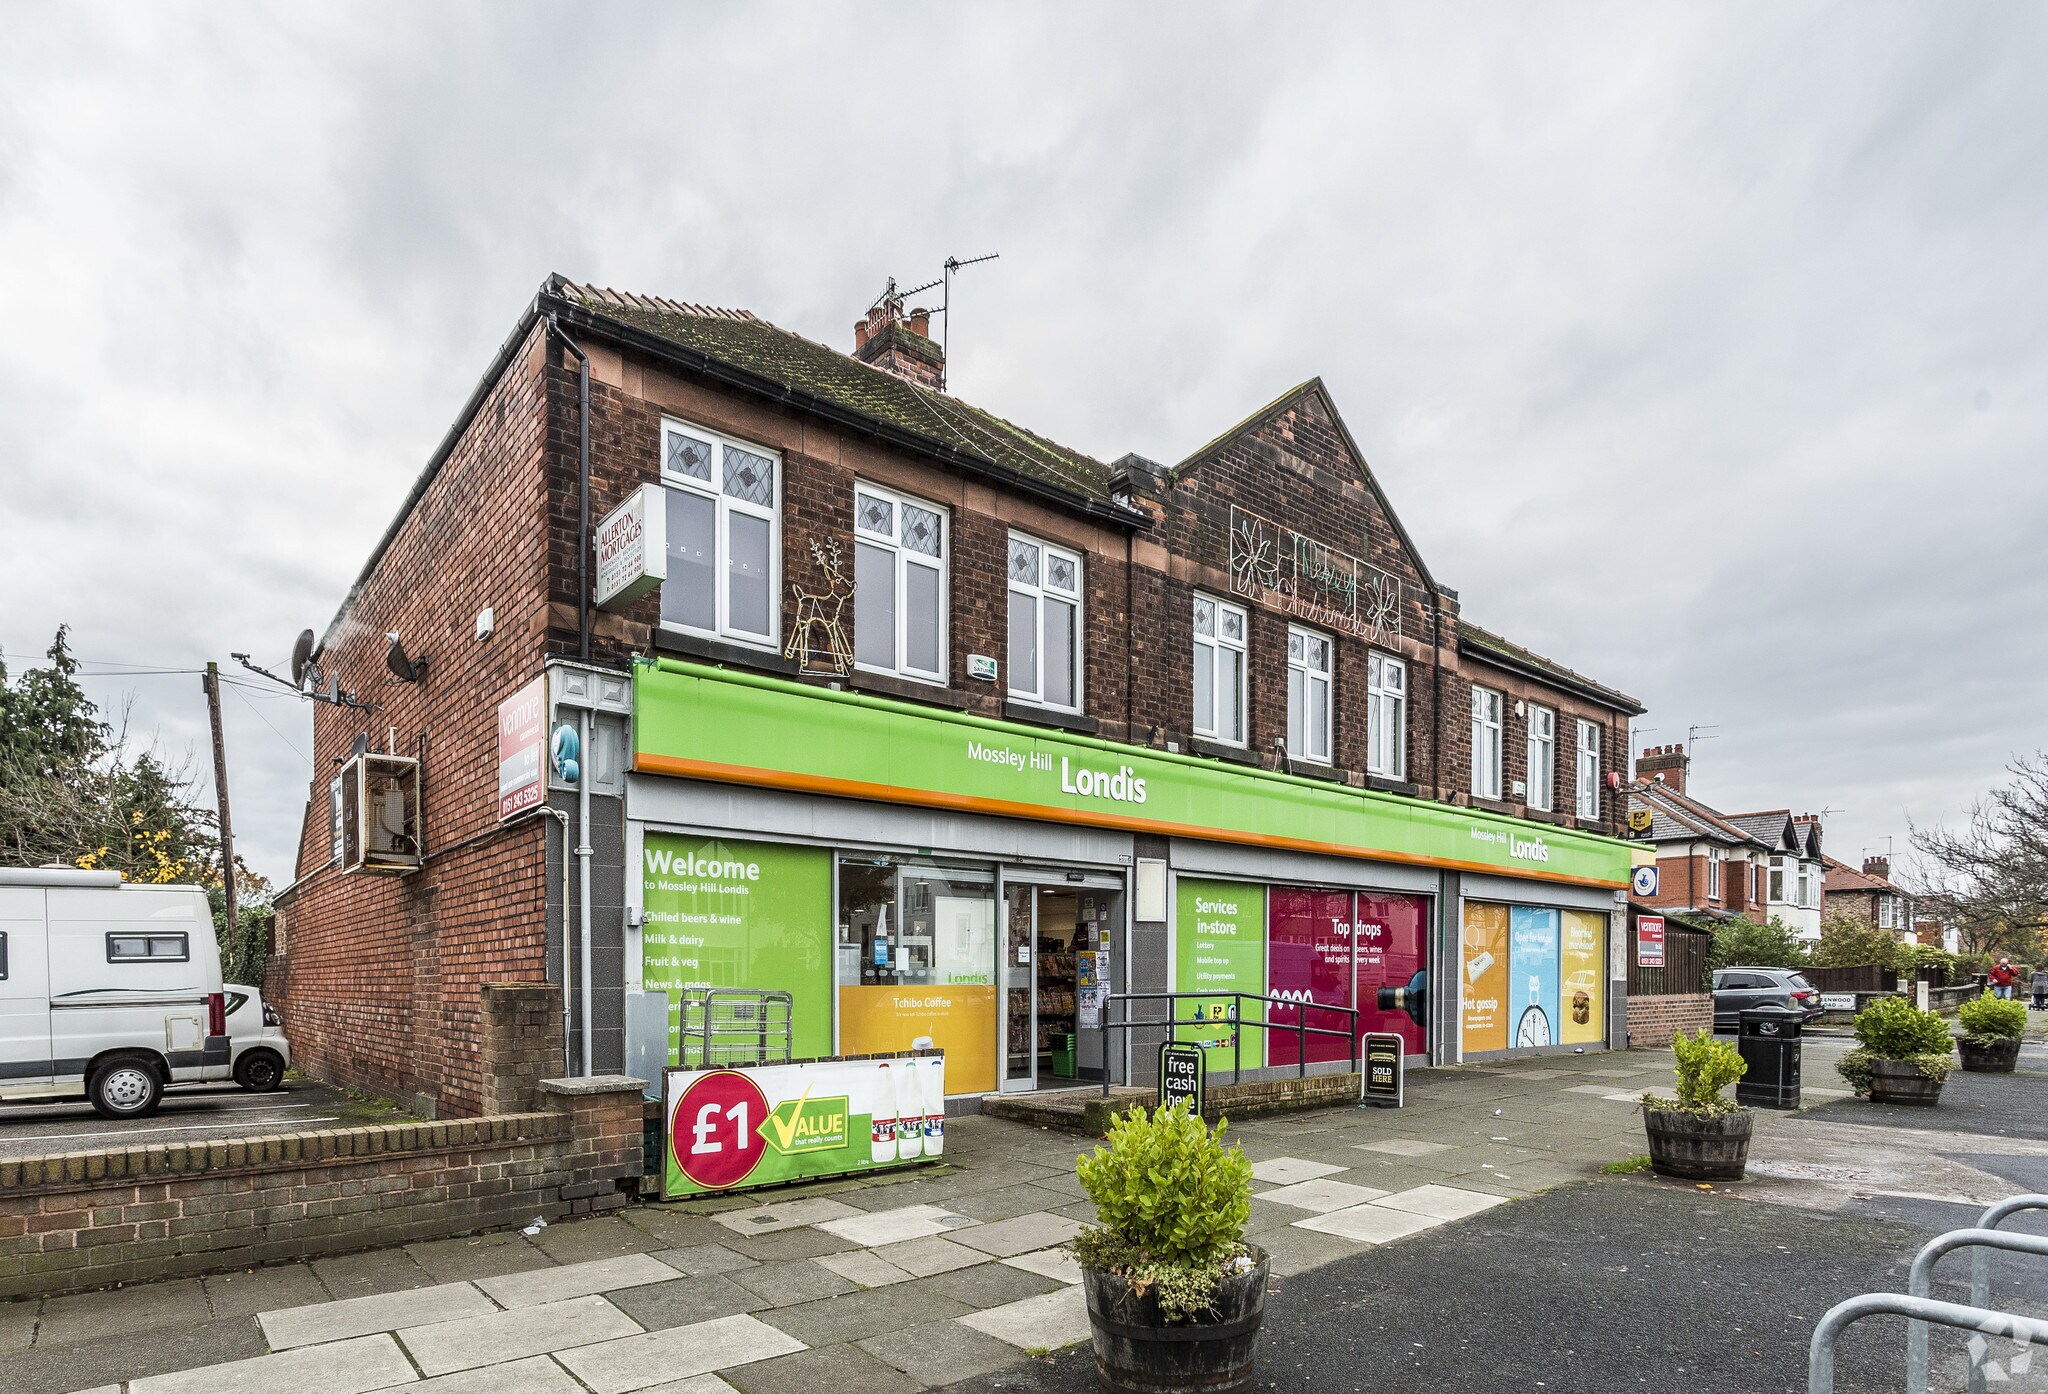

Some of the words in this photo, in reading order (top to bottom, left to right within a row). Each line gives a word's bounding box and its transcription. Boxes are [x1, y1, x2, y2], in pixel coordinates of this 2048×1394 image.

[601, 509, 634, 548] ALLERTON
[601, 519, 642, 565] MORTGAGES
[503, 695, 539, 738] venmore
[967, 740, 1026, 771] Mossley
[1030, 751, 1052, 771] Hill
[1061, 756, 1147, 803] Londis
[1471, 826, 1496, 844] Mossley
[1497, 831, 1507, 844] Hill
[1510, 833, 1549, 862] Londis
[644, 849, 760, 881] Welcome
[644, 880, 655, 890] to
[658, 880, 698, 894] Mossley
[700, 883, 716, 893] Hill
[719, 884, 749, 895] Londis
[1195, 897, 1237, 916] Services
[644, 911, 679, 923] Chilled
[681, 912, 707, 923] beers
[710, 913, 718, 924] &
[719, 915, 741, 925] wine
[1197, 918, 1237, 935] in-store
[1332, 918, 1350, 939] Top
[1356, 919, 1382, 940] drops
[1641, 922, 1662, 933] venmore
[645, 933, 666, 944] Milk
[669, 934, 678, 945] &
[679, 935, 704, 947] dairy
[1196, 941, 1214, 950] Lottery
[1315, 943, 1329, 952] Great
[1330, 944, 1343, 953] deals
[645, 956, 669, 966] Fruit
[671, 956, 680, 967] &
[681, 958, 698, 969] veg
[1214, 957, 1222, 965] top
[1324, 955, 1334, 963] and
[1335, 955, 1350, 965] spirits
[1368, 956, 1380, 964] week
[948, 971, 988, 985] Londis
[1196, 972, 1212, 981] Utility
[1213, 973, 1235, 981] payments
[645, 979, 672, 989] News
[675, 979, 683, 989] &
[893, 997, 922, 1008] Tchibo
[924, 996, 952, 1008] Coffee
[1462, 996, 1475, 1010] Hot
[1476, 996, 1498, 1013] gossip
[1168, 1056, 1195, 1075] free
[1372, 1066, 1392, 1075] SOLD
[1165, 1074, 1197, 1092] cash
[1372, 1075, 1392, 1083] HERE
[690, 1101, 748, 1155] £1
[808, 1135, 823, 1144] really
[824, 1134, 843, 1142] counts
